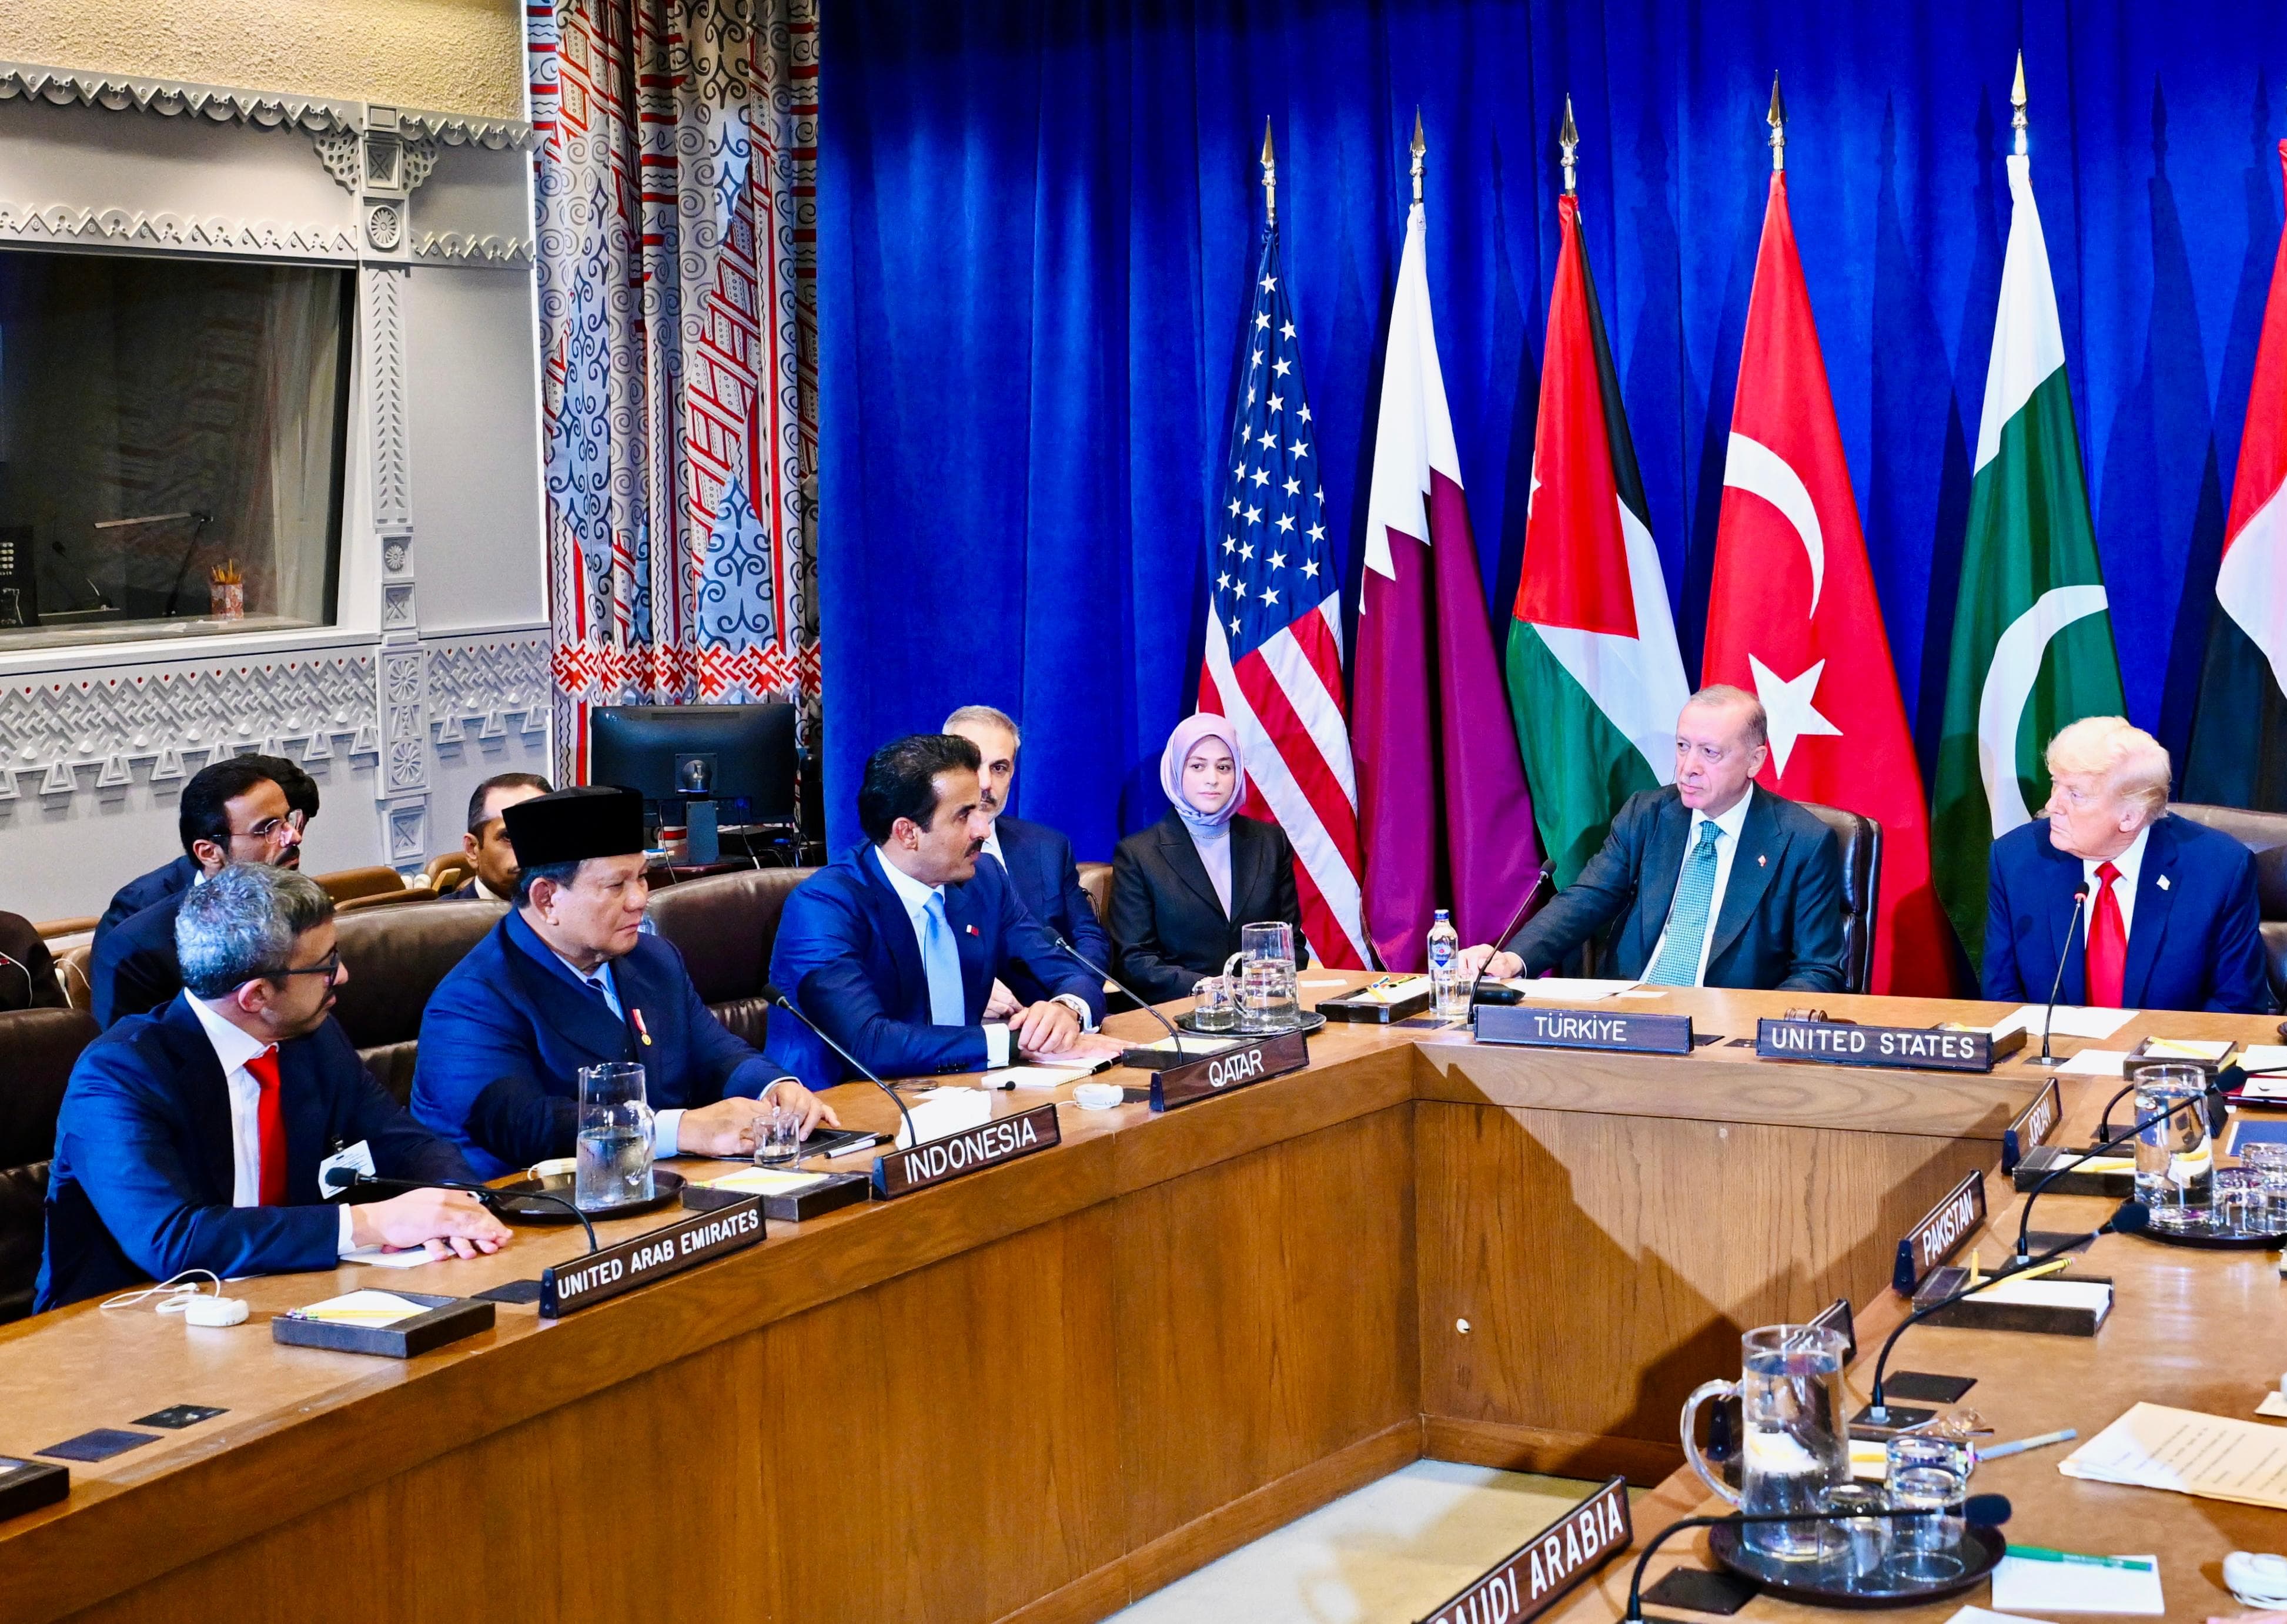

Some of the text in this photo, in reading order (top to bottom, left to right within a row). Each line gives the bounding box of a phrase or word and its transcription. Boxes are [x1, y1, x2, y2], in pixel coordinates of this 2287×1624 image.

[1534, 1012, 1627, 1042] TÜRKİYE
[1771, 1027, 1977, 1059] UNITED STATES
[1208, 1049, 1265, 1087] QATAR
[904, 1117, 1037, 1184] INDONESIA
[2028, 1097, 2051, 1147] JORDAN
[557, 1208, 759, 1299] UNITED ARAB EMIRATES
[1922, 1188, 1974, 1267] PAKISTAN
[1435, 1492, 1624, 1624] UDI ARABIA
